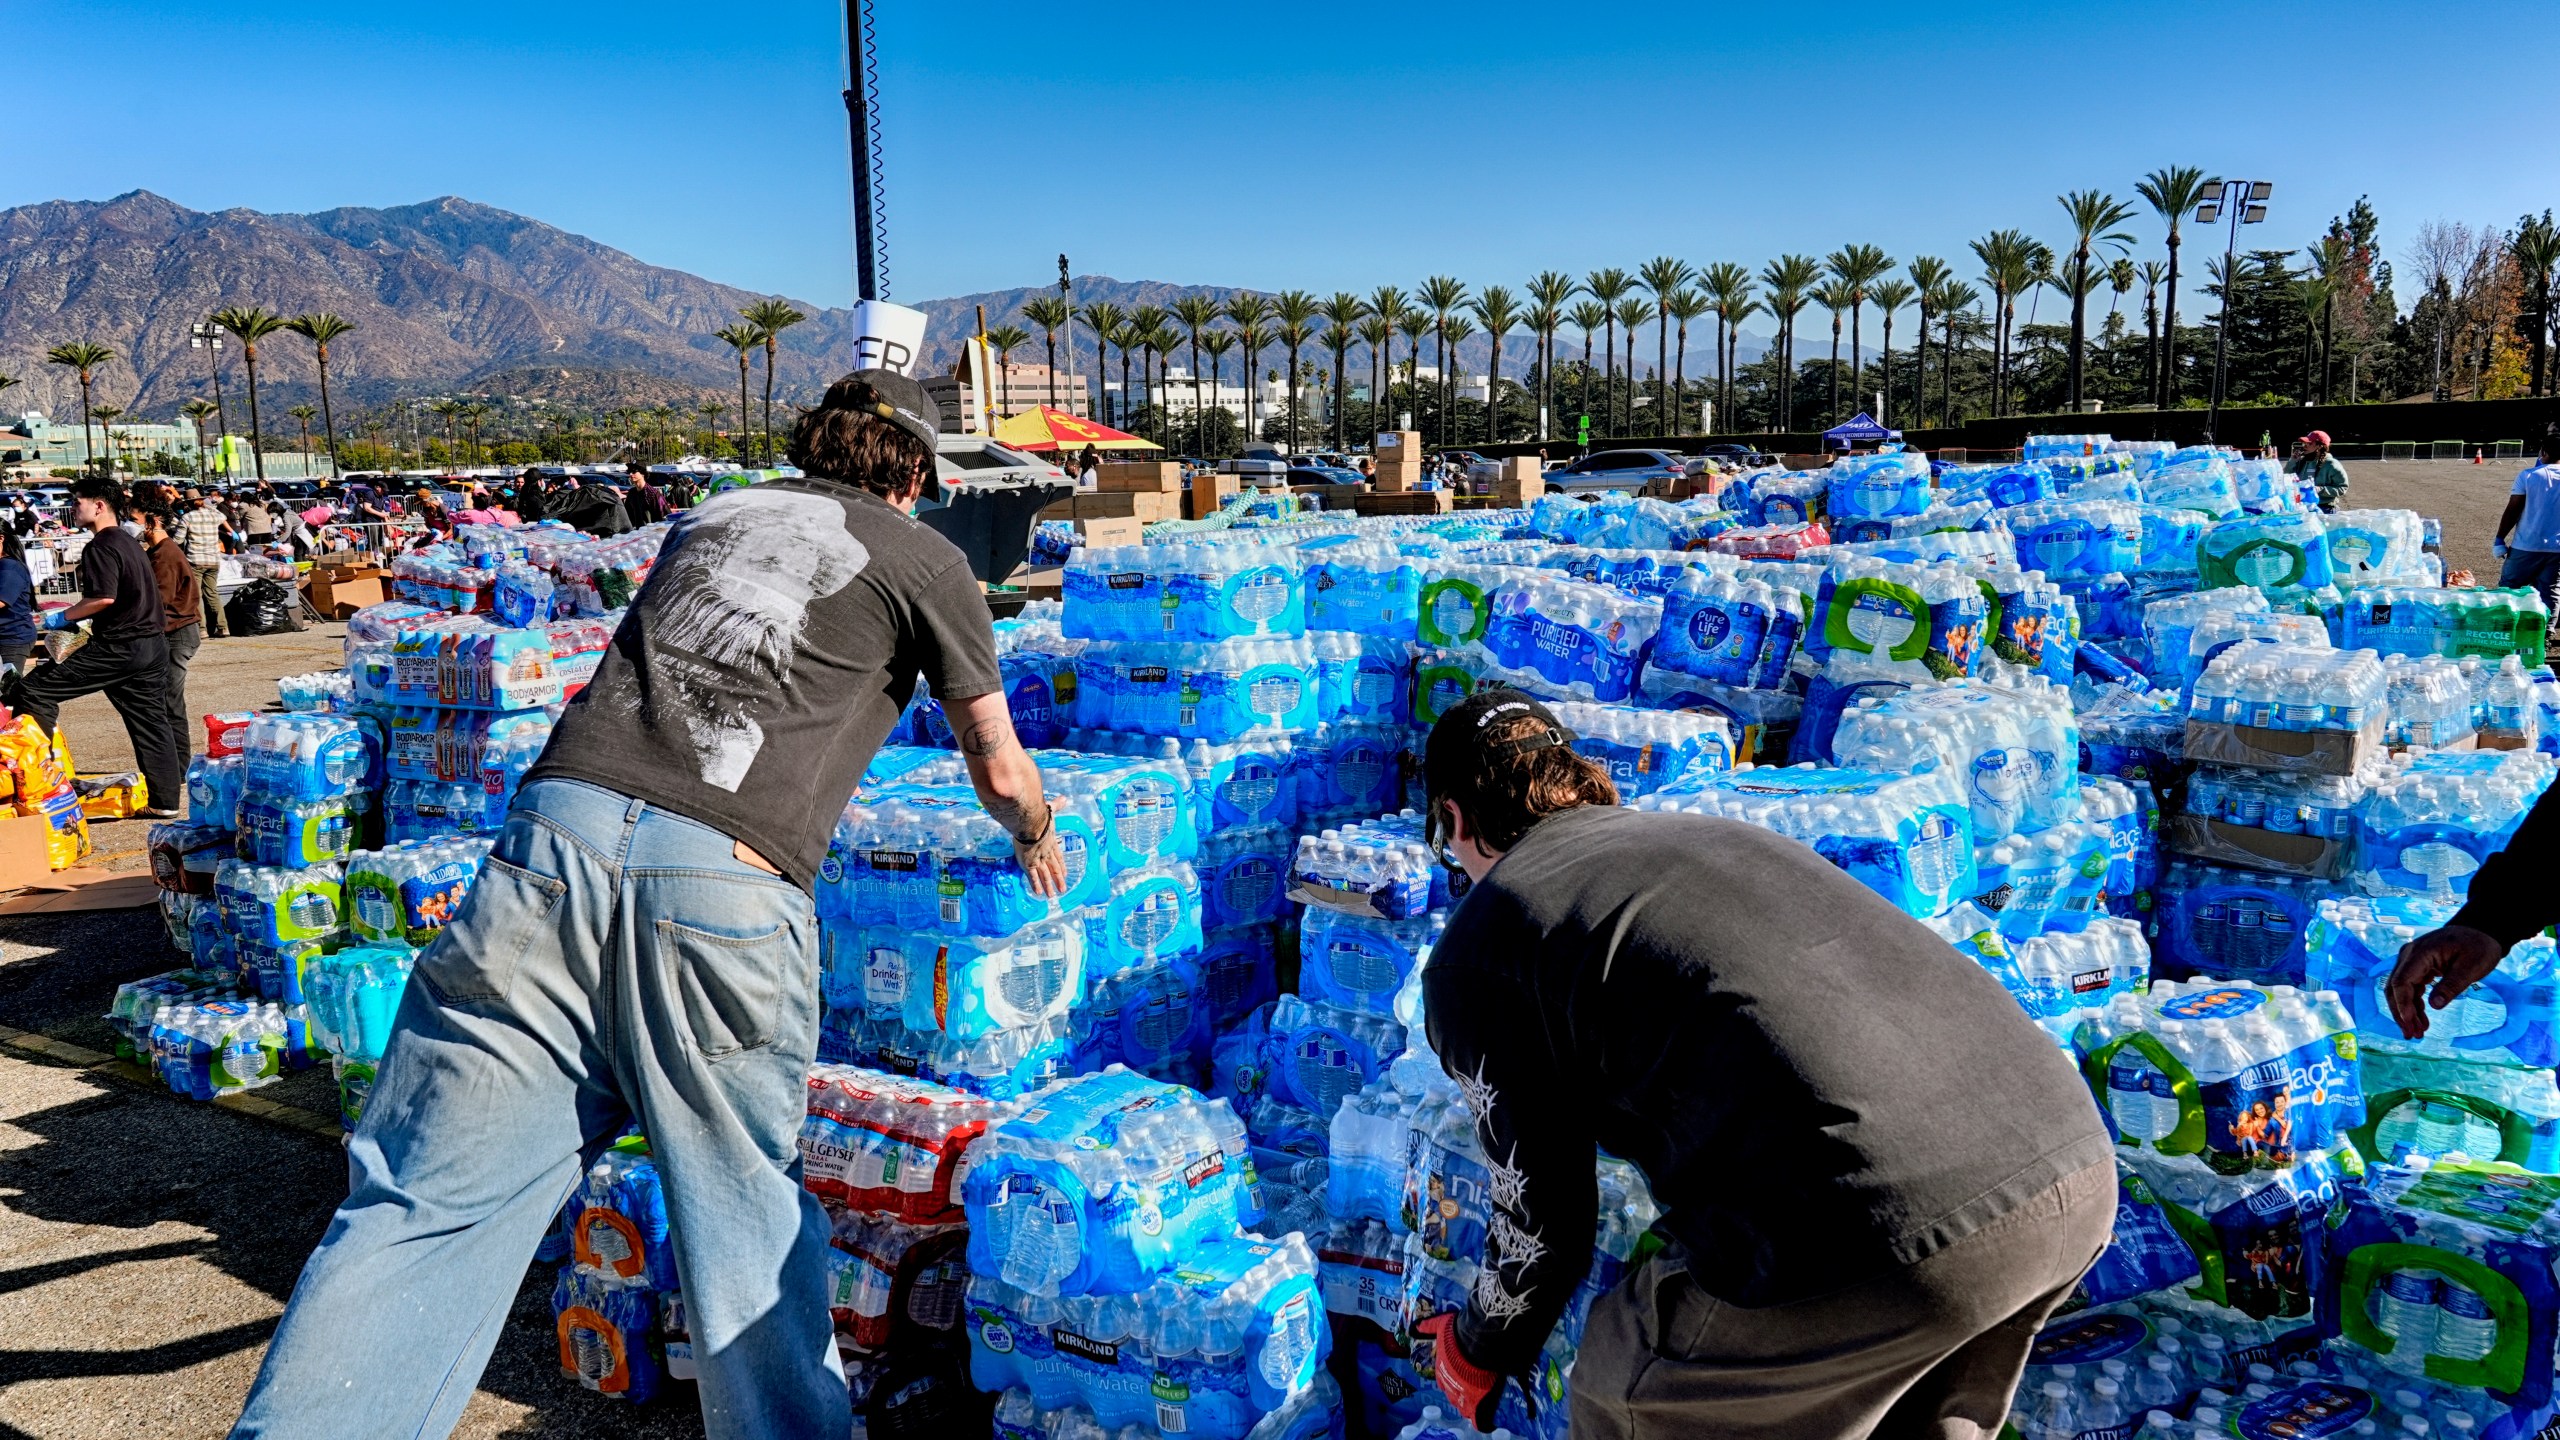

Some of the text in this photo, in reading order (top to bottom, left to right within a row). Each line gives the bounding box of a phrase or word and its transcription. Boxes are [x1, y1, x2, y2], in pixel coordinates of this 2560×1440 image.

[1742, 605, 1749, 613] 6
[1697, 609, 1726, 628] Pure
[1531, 620, 1581, 649] PURIFIED
[1697, 622, 1721, 635] Life
[2357, 626, 2435, 635] PURIFIED WATER
[2466, 630, 2510, 640] RECYCLE
[1535, 638, 1569, 659] WATER
[397, 657, 437, 667] BODYARMOR
[507, 684, 558, 700] BODYARMOR
[1477, 701, 1530, 727] ONLINE CERAMICS
[395, 732, 435, 743] BODYARMOR
[1979, 752, 2005, 763] Great
[2130, 749, 2140, 757] 24
[484, 774, 503, 786] 40
[2273, 812, 2292, 823] nice
[873, 852, 915, 865] KIRKLAND
[2086, 859, 2105, 871] 24
[822, 864, 839, 873] 50%
[899, 881, 936, 897] water
[1988, 889, 2014, 901] FIRS
[872, 968, 904, 984] Drinking
[2073, 970, 2110, 987] KIRKLA
[2339, 1038, 2357, 1050] 24
[2240, 1059, 2280, 1089] QUALITY
[824, 1110, 836, 1121] THE
[817, 1143, 855, 1163] GEYSER
[824, 1162, 844, 1172] WATER
[1184, 1152, 1224, 1179] KIRKLAN
[1141, 1210, 1158, 1227] 50%
[2135, 1226, 2157, 1235] WATER
[1358, 1276, 1376, 1291] 35
[987, 1331, 1010, 1342] 50%
[1057, 1331, 1114, 1357] KIRKLAND
[2233, 1348, 2269, 1372] UALITY
[1035, 1358, 1145, 1394] purified water
[1154, 1374, 1170, 1387] 40
[1152, 1386, 1185, 1398] BOTTLES
